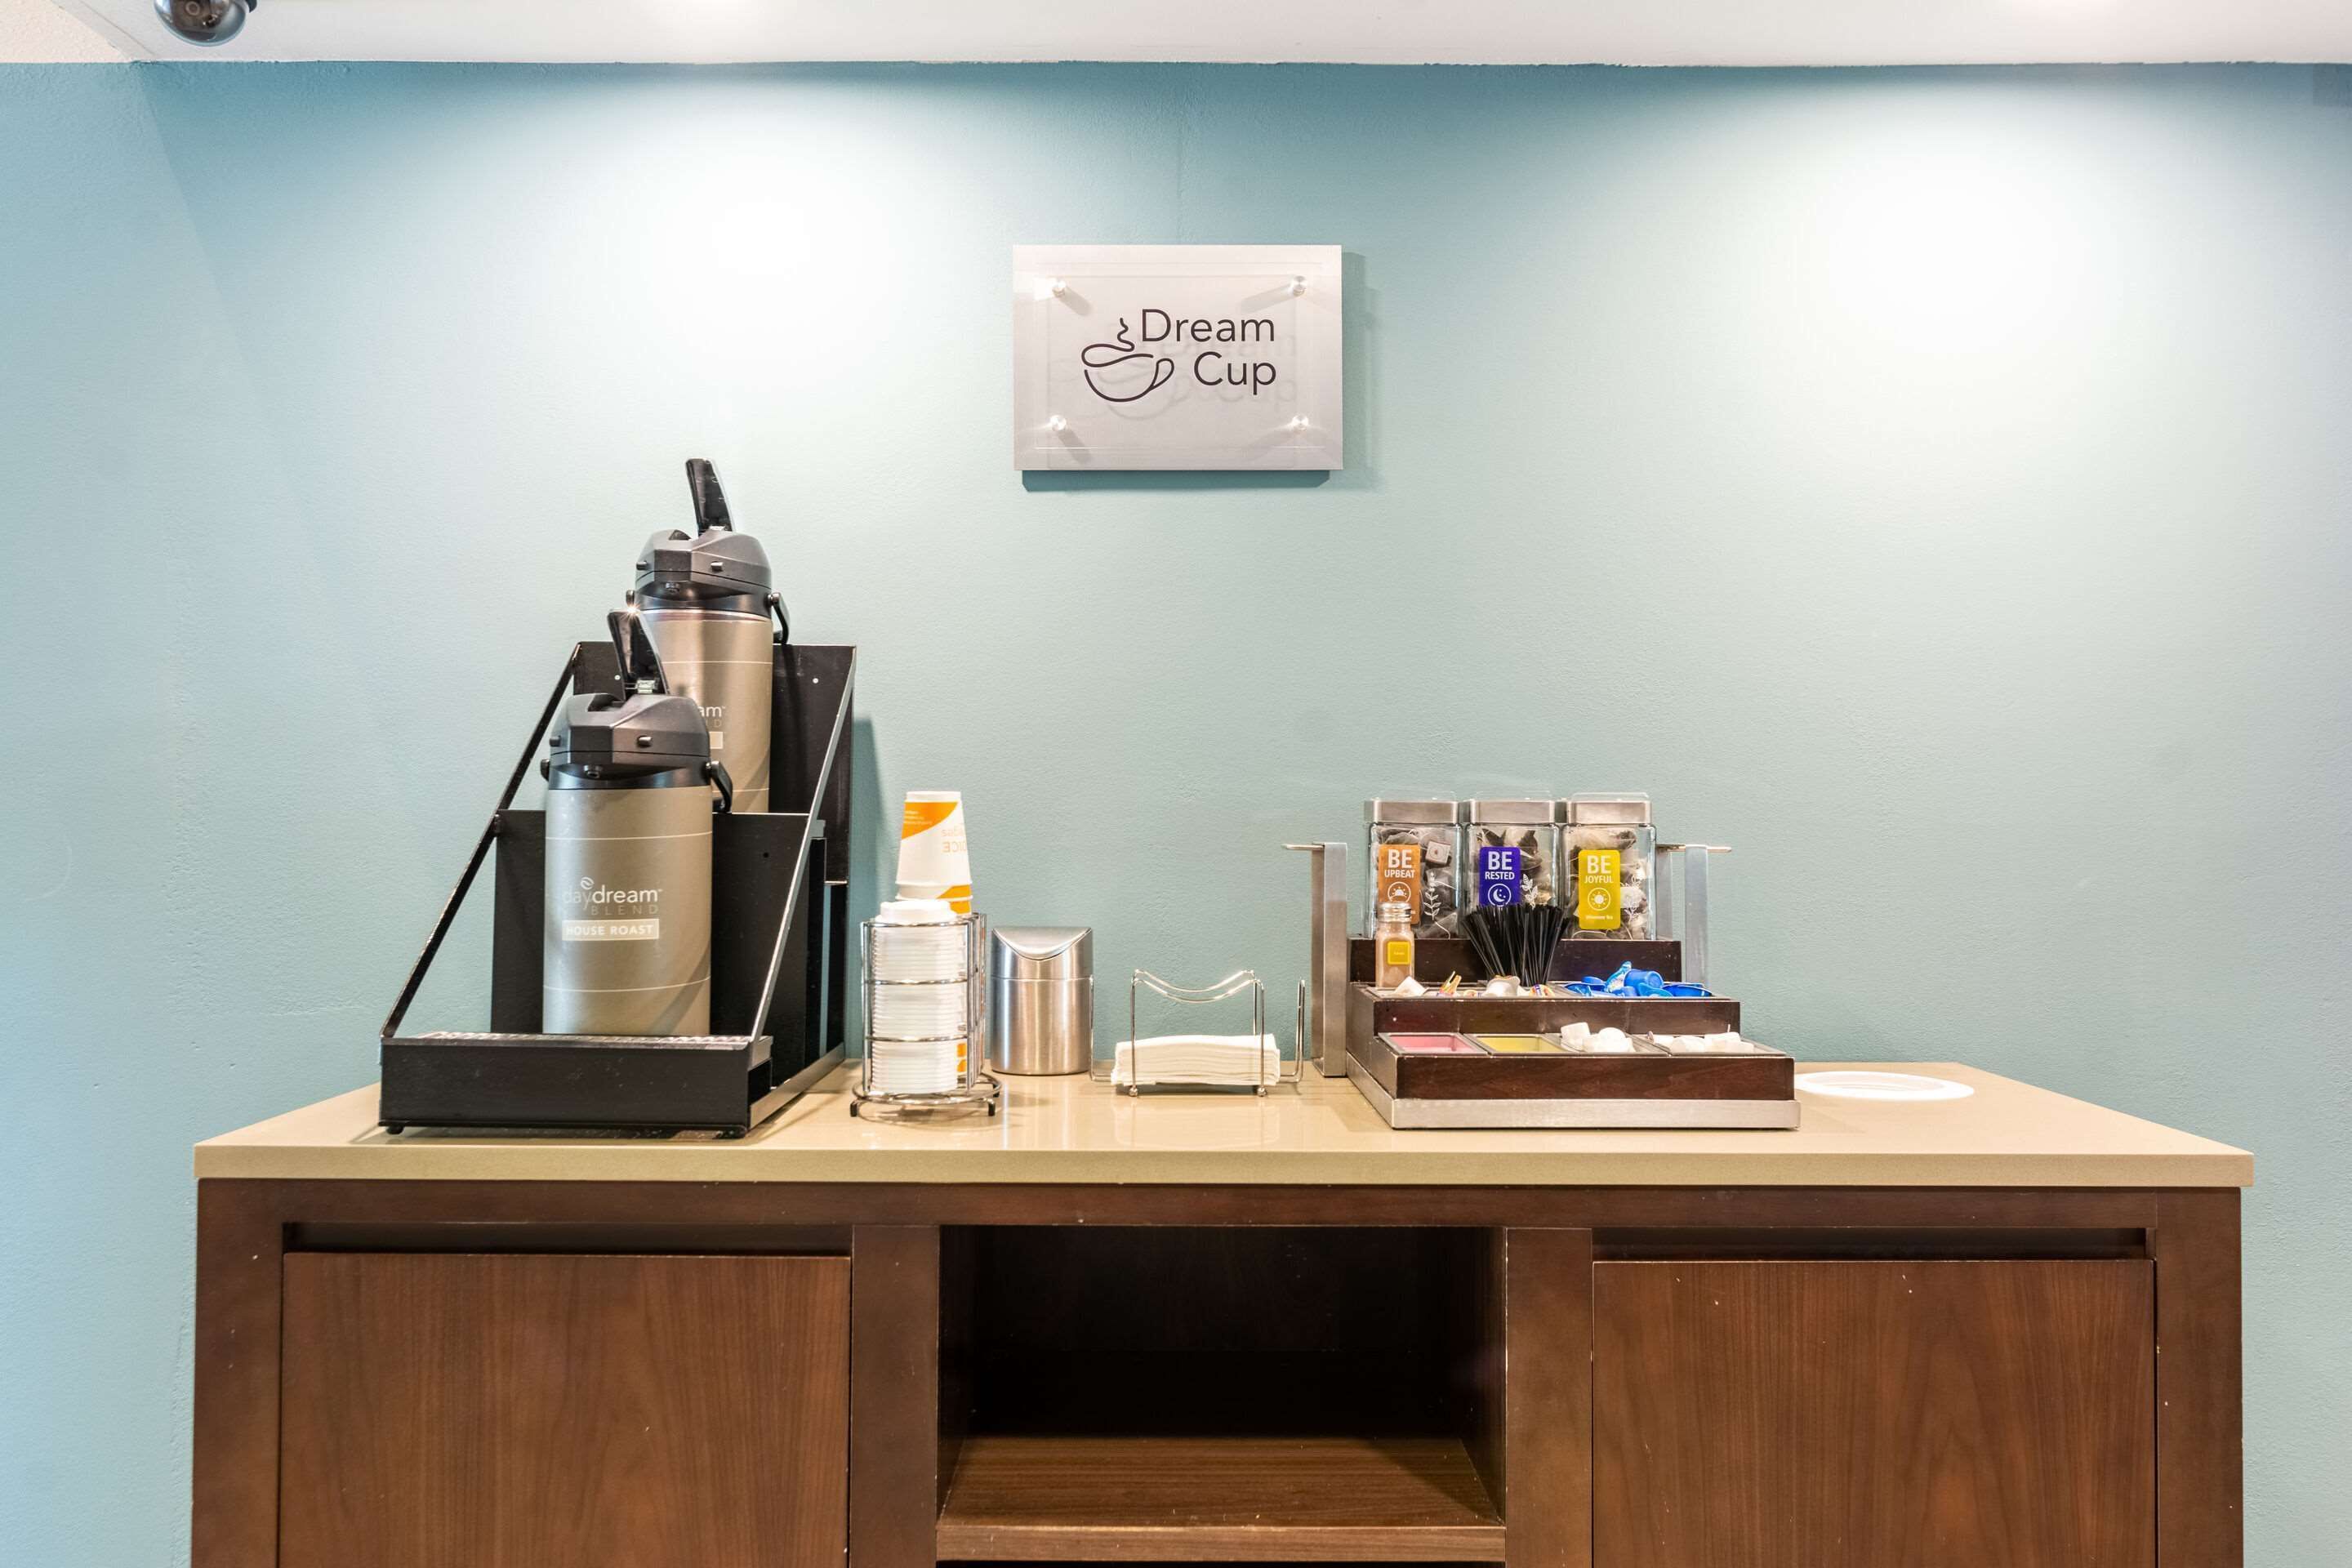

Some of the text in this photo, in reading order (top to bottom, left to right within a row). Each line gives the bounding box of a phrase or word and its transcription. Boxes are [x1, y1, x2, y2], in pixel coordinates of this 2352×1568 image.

[1142, 309, 1275, 342] Dream
[1194, 351, 1276, 395] Cup
[1388, 849, 1412, 869] BE
[1487, 851, 1512, 871] BE
[1587, 855, 1611, 874] BE
[1384, 870, 1415, 878] UPBEAT
[1485, 871, 1515, 880] RESTED
[1584, 875, 1614, 884] JOYFUL
[591, 904, 659, 915] BLEND
[566, 924, 653, 936] HOUSE ROAST
